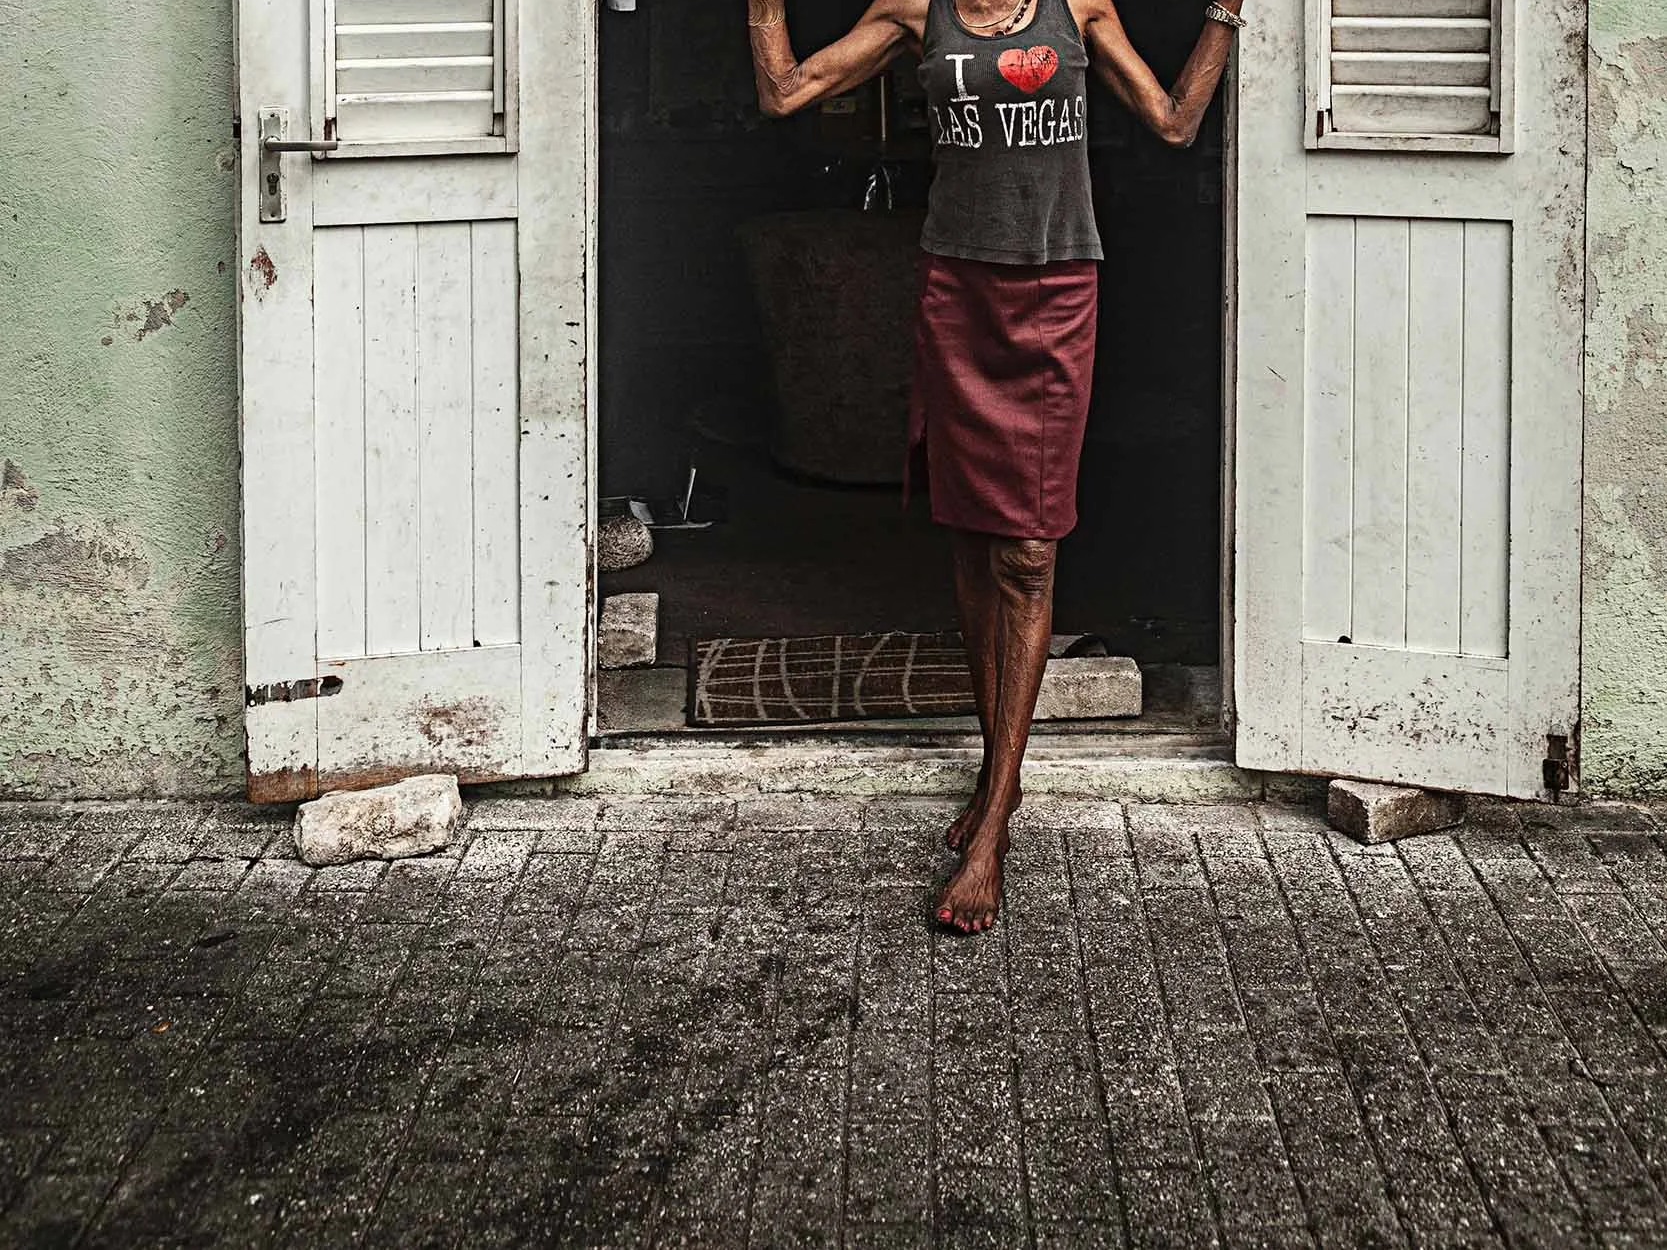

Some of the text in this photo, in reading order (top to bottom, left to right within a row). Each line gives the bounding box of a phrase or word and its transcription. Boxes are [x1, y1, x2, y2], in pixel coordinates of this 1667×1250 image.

[945, 54, 980, 102] I
[929, 96, 1084, 148] LAS VEGAS
